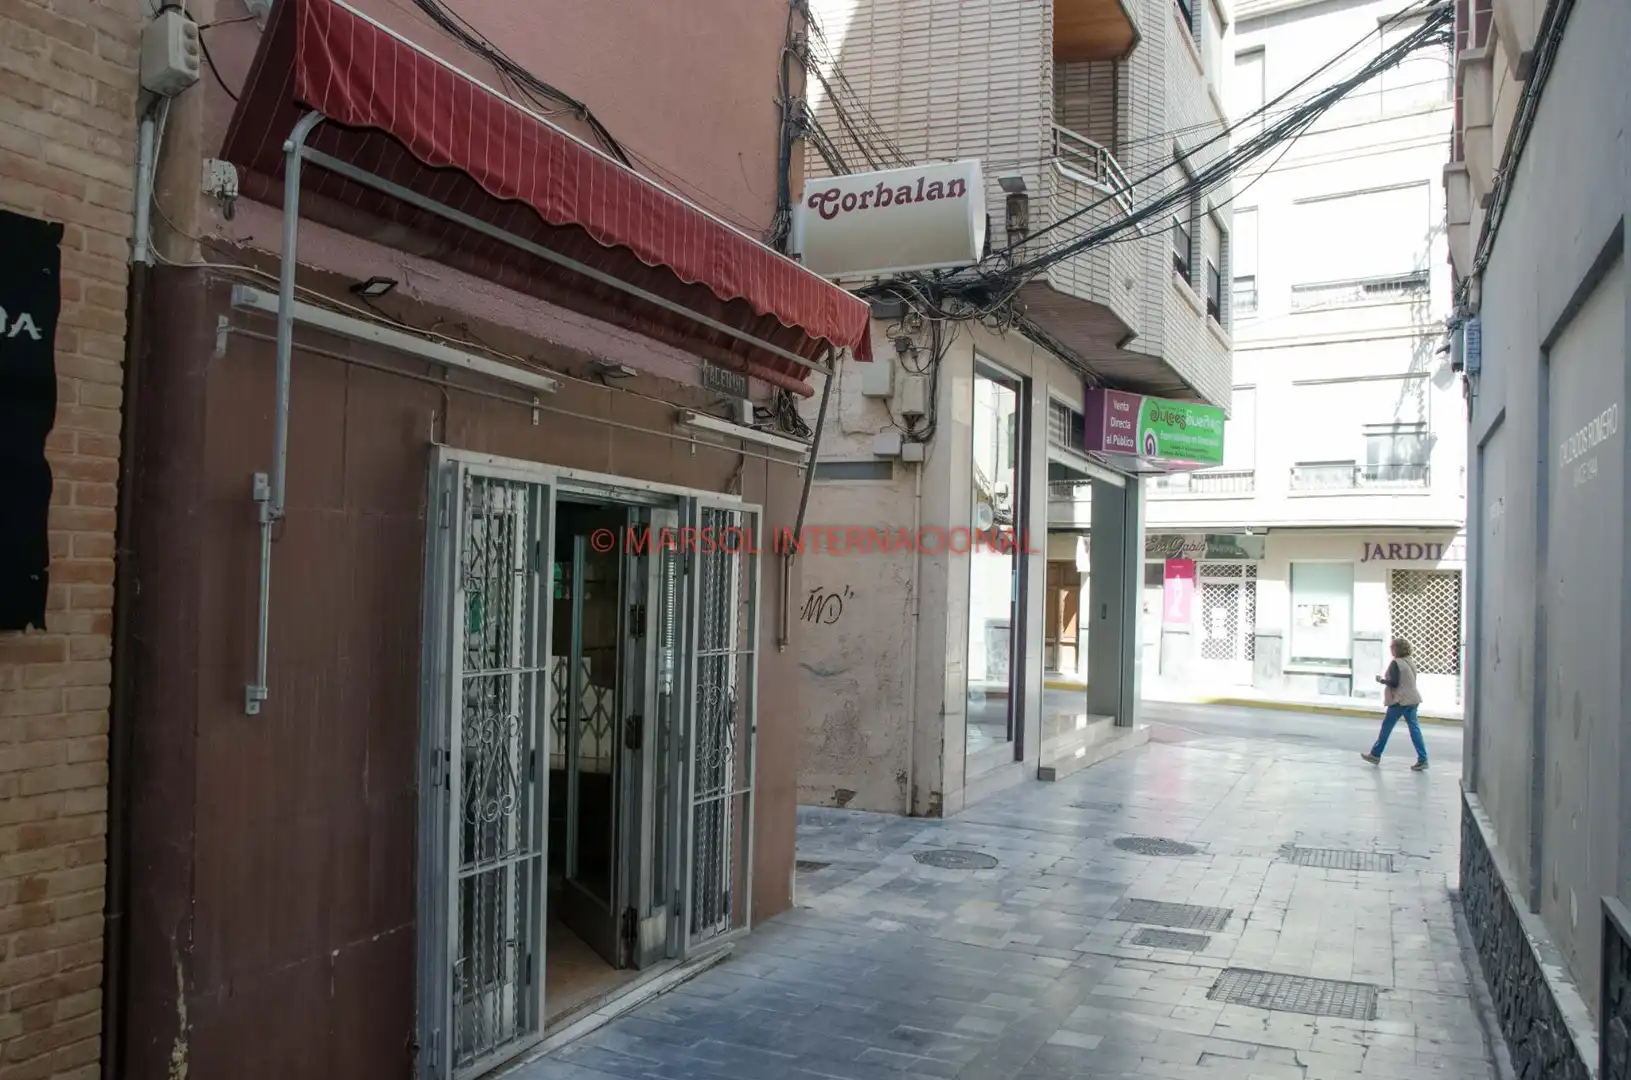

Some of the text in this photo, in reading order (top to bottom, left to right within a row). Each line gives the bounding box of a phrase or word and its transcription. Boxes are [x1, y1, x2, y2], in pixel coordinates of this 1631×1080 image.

[807, 176, 967, 221] Corbalan
[1112, 397, 1130, 412] Venta
[1110, 416, 1131, 430] Directa
